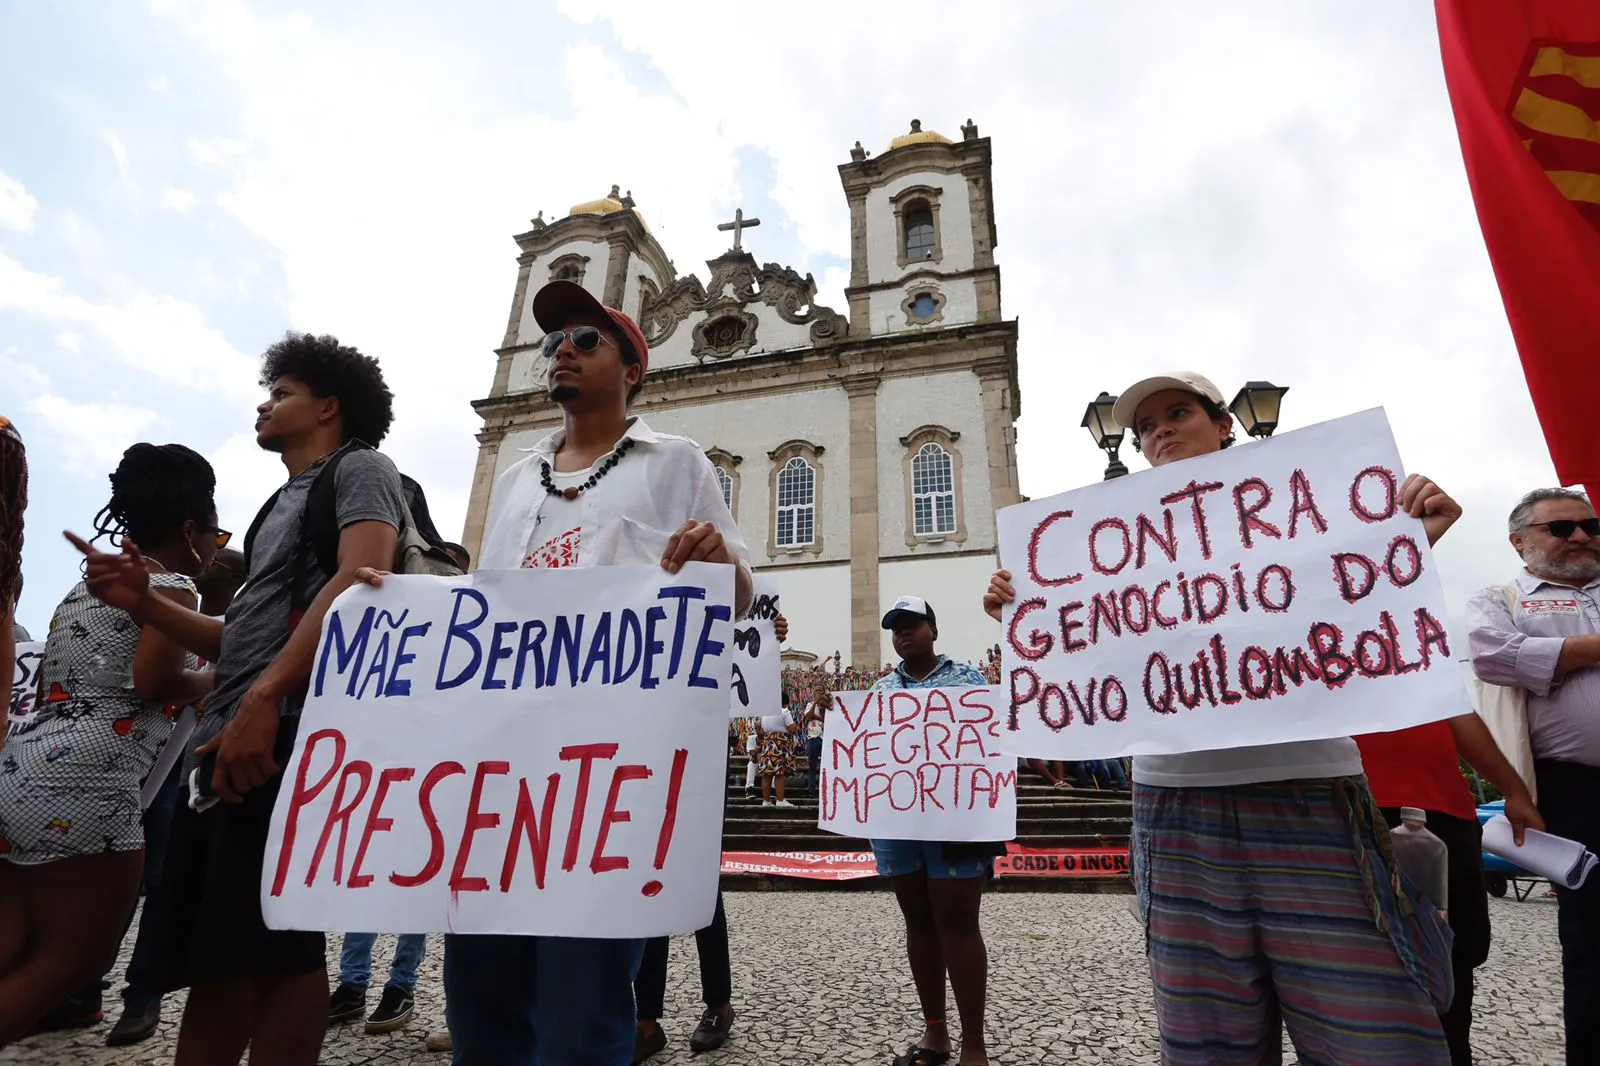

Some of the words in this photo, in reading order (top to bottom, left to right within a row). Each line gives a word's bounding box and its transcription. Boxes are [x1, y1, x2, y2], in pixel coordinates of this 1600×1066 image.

[1027, 468, 1328, 588] CONTRA
[1349, 465, 1399, 523] O
[1330, 533, 1425, 604] DO
[314, 606, 432, 700] MÃE
[435, 587, 731, 690] BERNADETE
[1007, 666, 1128, 732] POVO
[1143, 607, 1450, 714] QUILOMBOLA
[835, 689, 994, 732] VIDAS
[270, 728, 688, 898] PRESENTE!
[822, 762, 1017, 823] IMPORTAM
[1012, 855, 1060, 871] CADE
[1064, 855, 1076, 871] O
[1081, 855, 1128, 871] INCR
